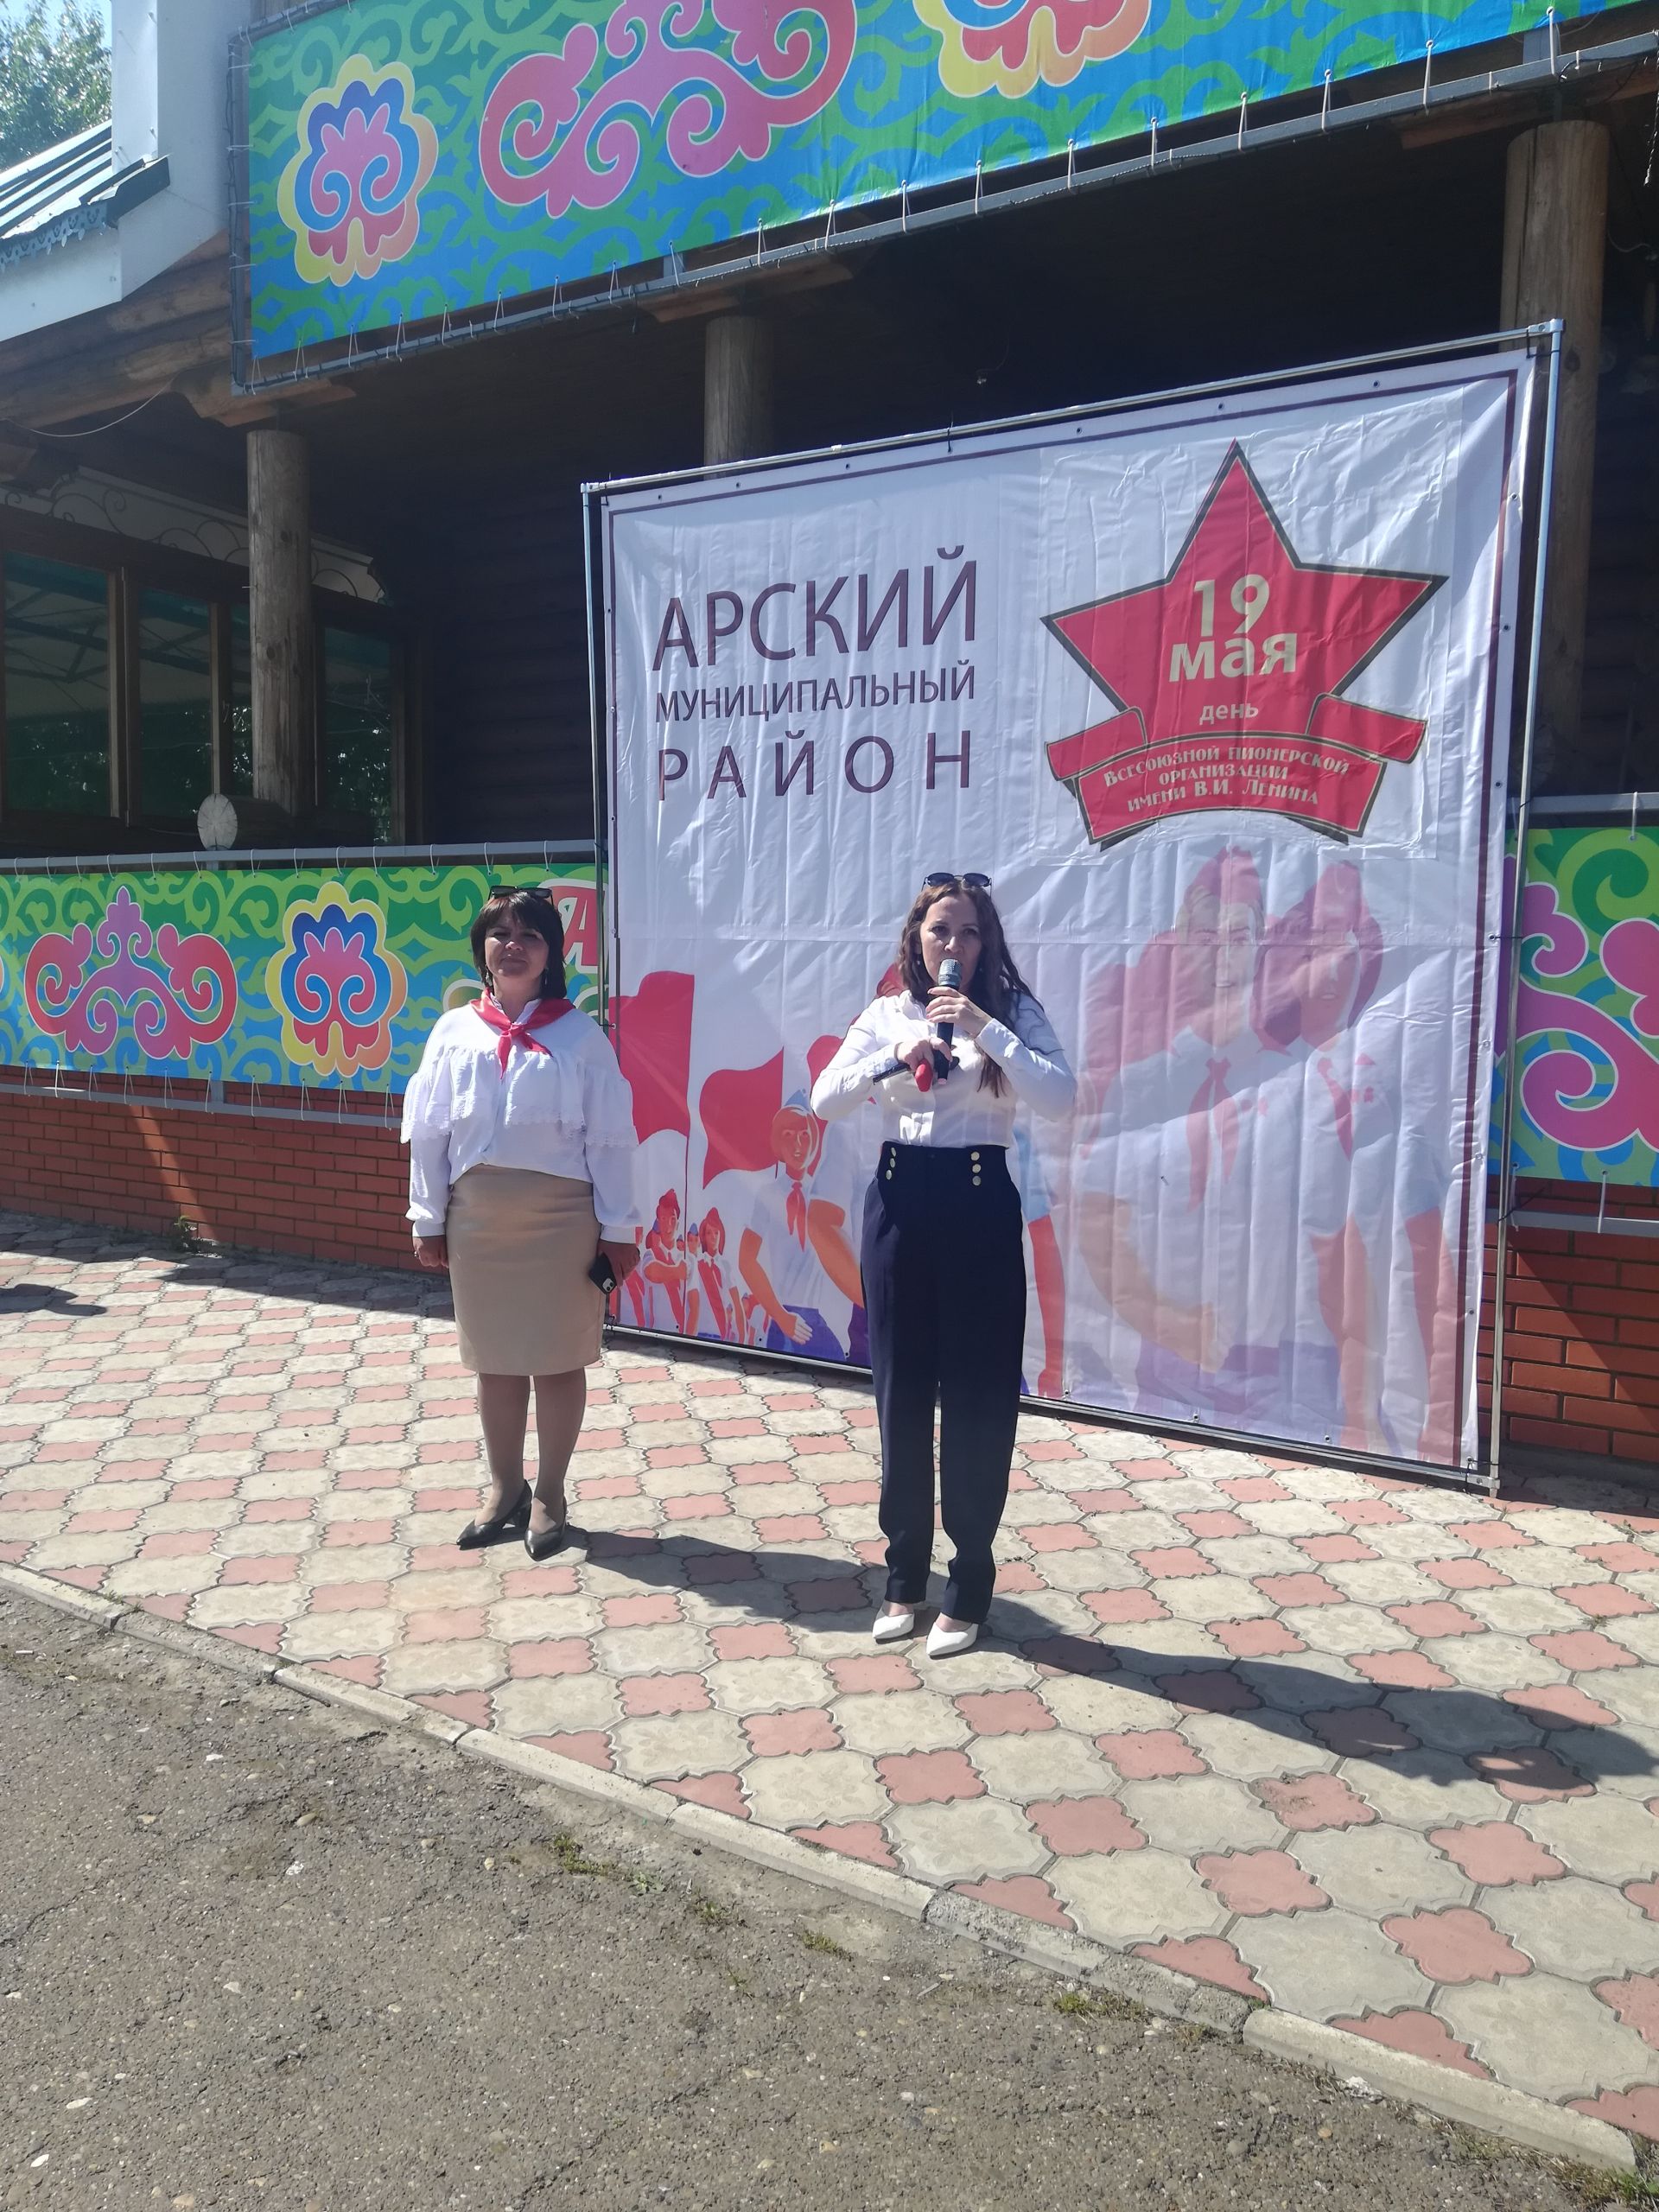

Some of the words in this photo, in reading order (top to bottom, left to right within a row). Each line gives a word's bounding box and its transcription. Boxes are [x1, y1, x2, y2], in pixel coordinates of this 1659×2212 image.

[652, 545, 976, 671] АРСКИЙ
[1194, 574, 1269, 639] 19
[1169, 632, 1298, 682] мая
[656, 659, 975, 722] МУНИЦИПАЛЬНЫЙ
[1199, 702, 1259, 726] день
[658, 729, 970, 801] РАЙОН
[1159, 763, 1288, 786] ОРГАНИЗАЦИИ
[1128, 786, 1186, 812] ИМЕНИ
